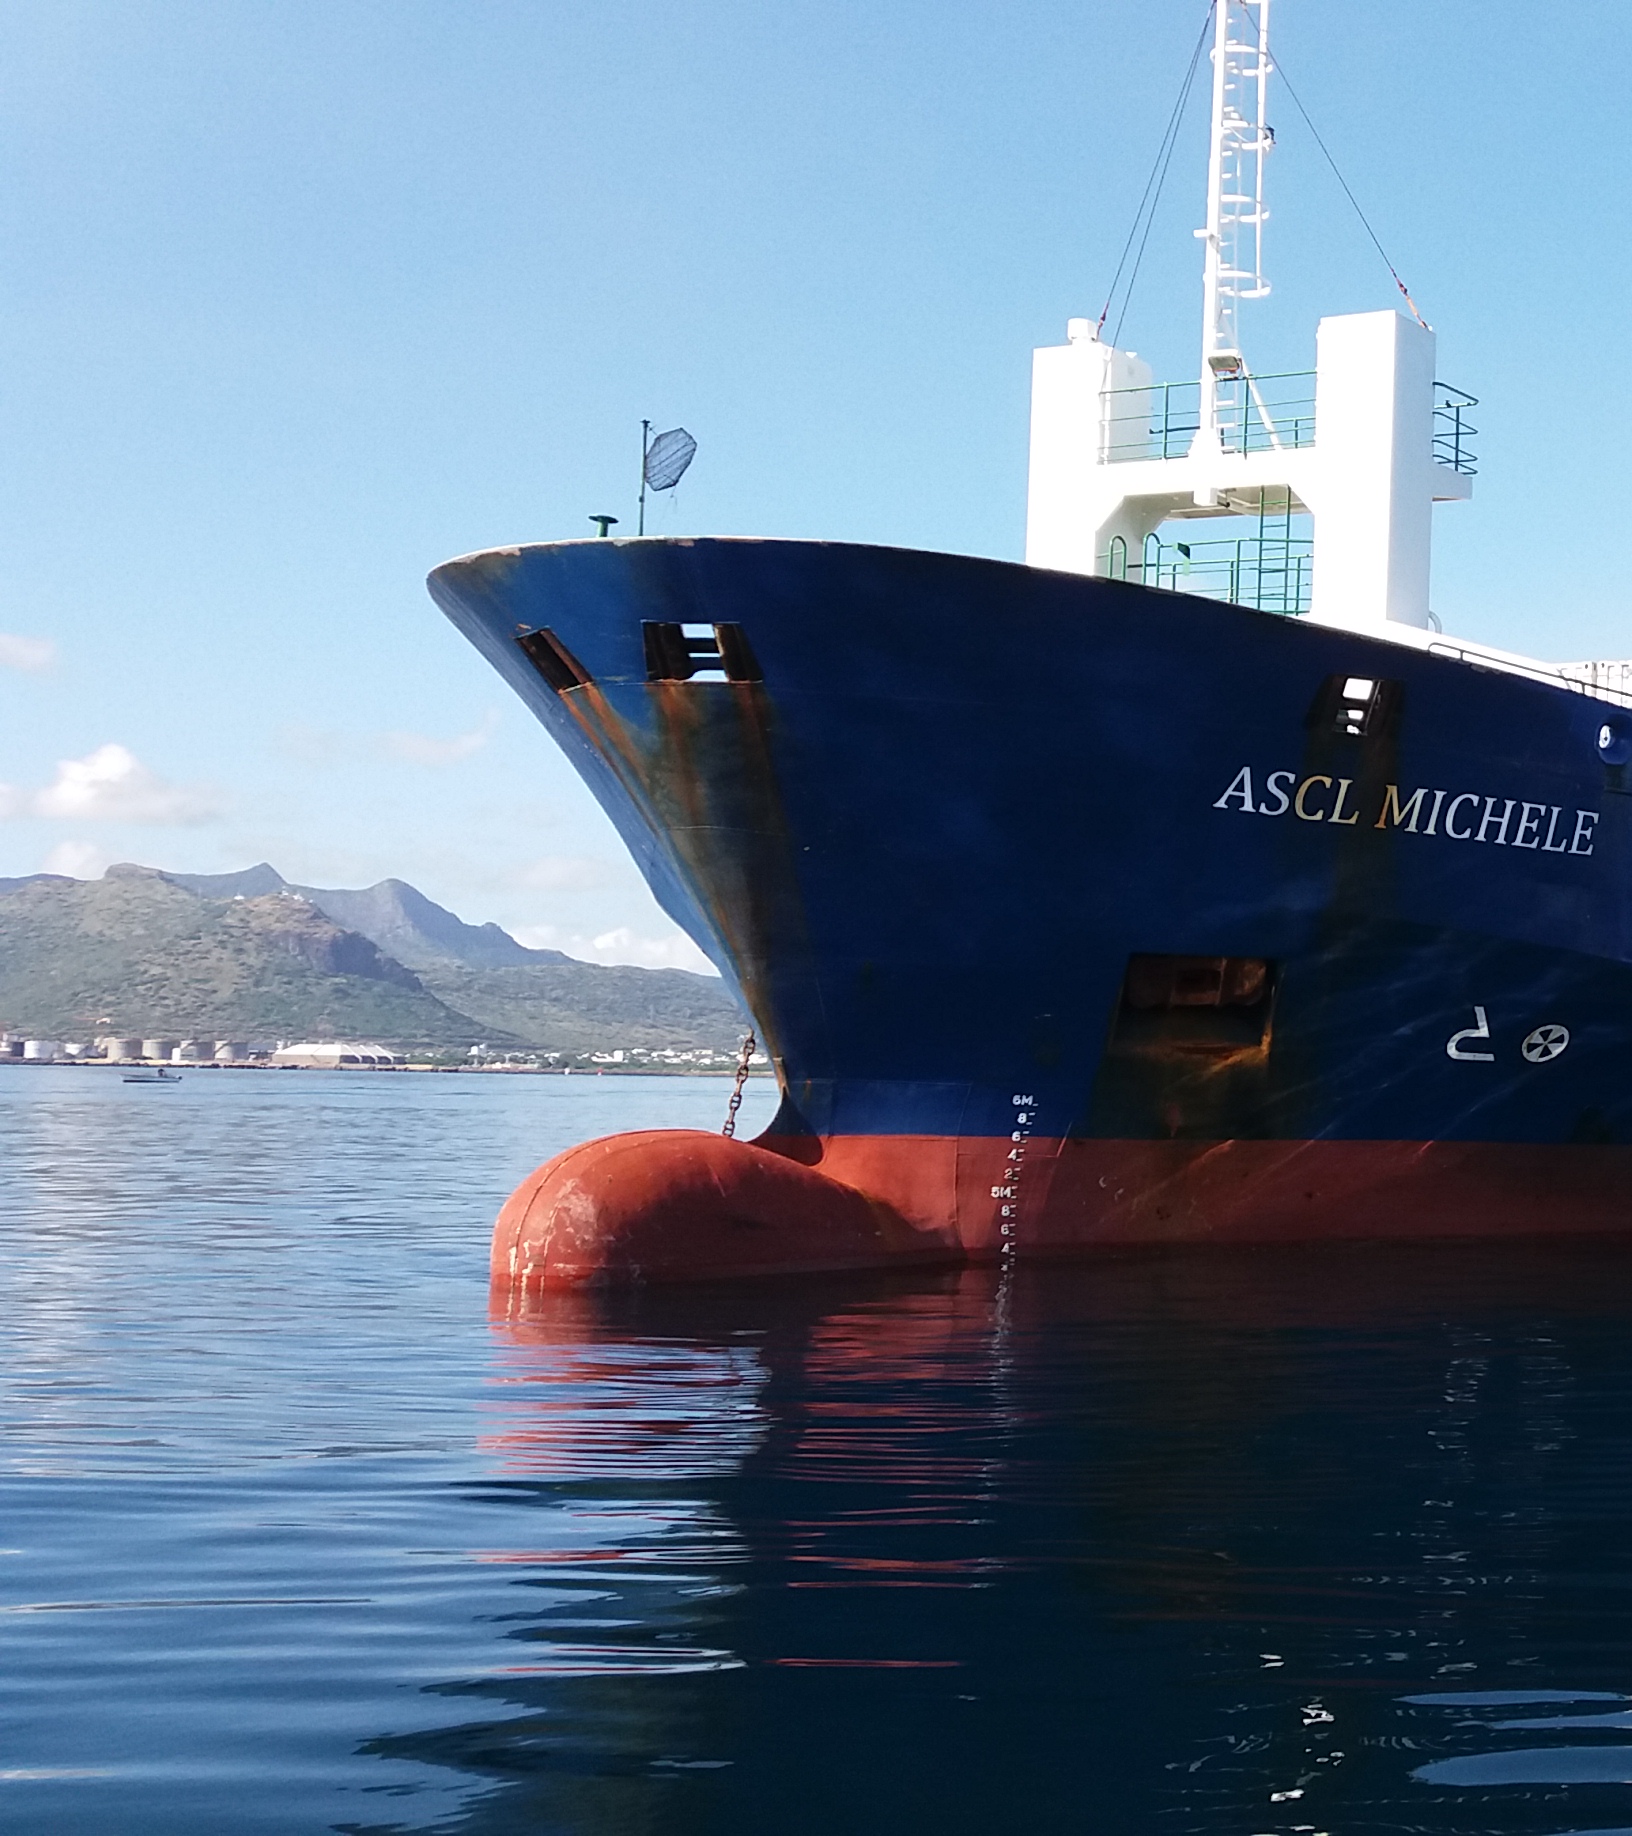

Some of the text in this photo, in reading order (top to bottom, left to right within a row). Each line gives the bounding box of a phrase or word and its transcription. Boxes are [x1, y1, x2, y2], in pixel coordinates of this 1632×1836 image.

[1212, 766, 1600, 856] ASCL MICHELE
[1012, 1094, 1034, 1106] 6M
[1017, 1112, 1027, 1124] 8
[1011, 1131, 1021, 1143] 6
[1007, 1148, 1018, 1161] 4
[1004, 1168, 1013, 1180] 2
[990, 1186, 1012, 1199] 5M
[1001, 1205, 1010, 1217] 8
[1000, 1223, 1009, 1237] 6
